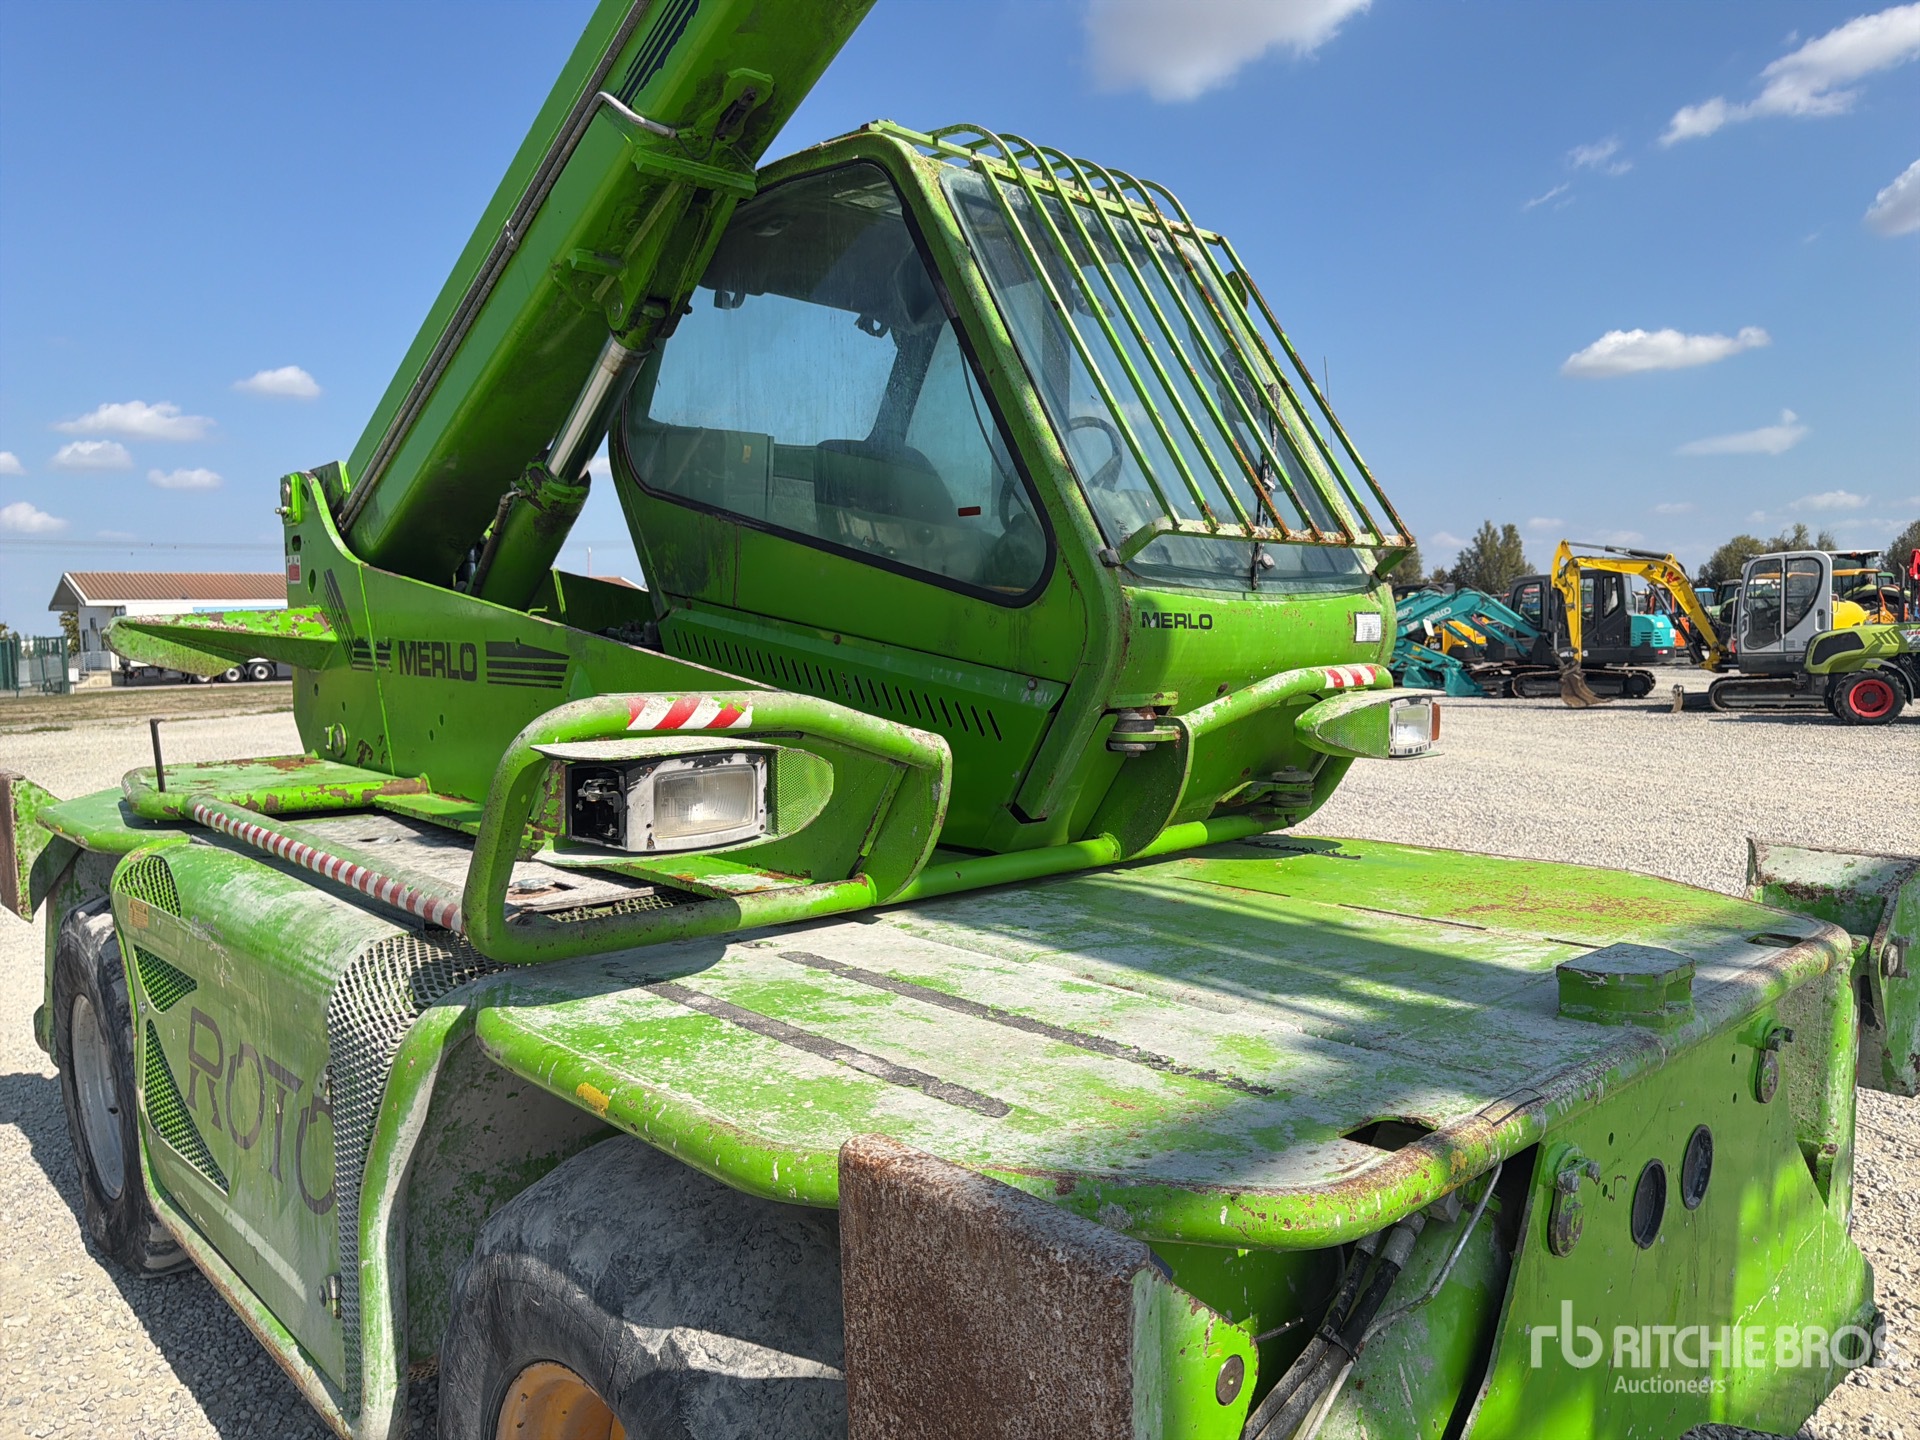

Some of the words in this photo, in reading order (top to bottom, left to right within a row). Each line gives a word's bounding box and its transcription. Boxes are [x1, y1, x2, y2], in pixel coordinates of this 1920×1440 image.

[1141, 611, 1213, 630] MERLO
[398, 640, 477, 682] MERLO
[186, 1006, 337, 1216] ROTO
